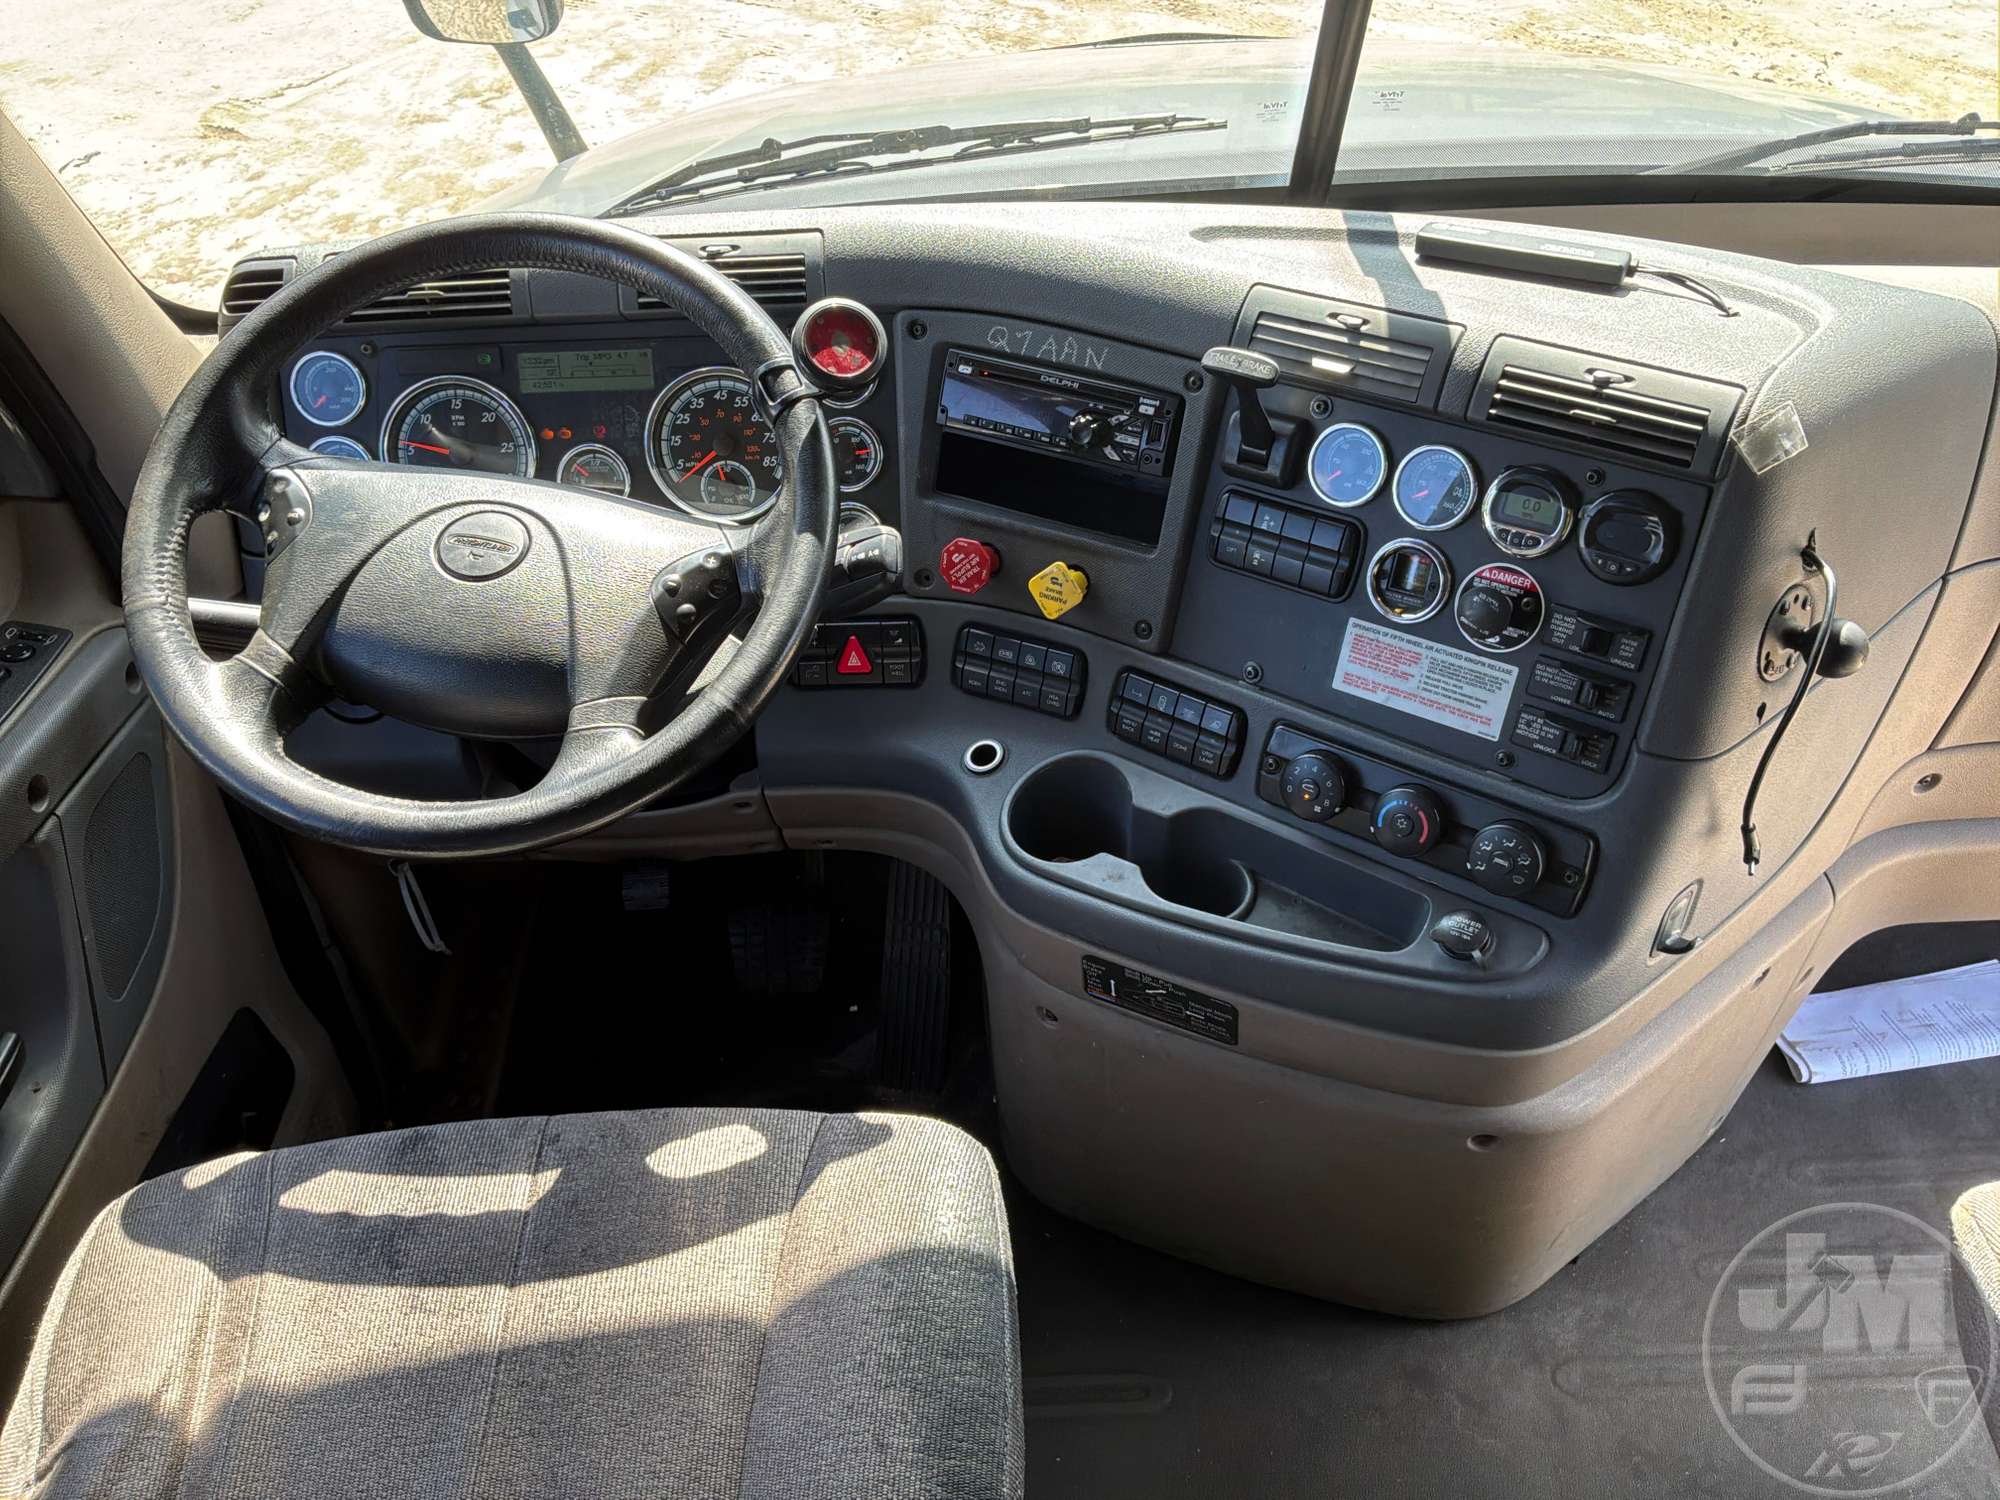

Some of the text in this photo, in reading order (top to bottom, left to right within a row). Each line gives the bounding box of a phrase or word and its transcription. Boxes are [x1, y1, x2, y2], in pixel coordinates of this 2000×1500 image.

[1040, 375, 1079, 389] DELPHI
[714, 390, 728, 400] 45
[451, 400, 462, 409] 15
[690, 398, 704, 408] 35
[734, 396, 749, 408] 55
[420, 414, 431, 424] 10
[481, 412, 496, 422] 20
[675, 413, 691, 424] 25
[670, 435, 682, 446] 15
[762, 433, 776, 443] 75
[408, 445, 415, 455] 5
[501, 442, 514, 453] 25
[676, 459, 684, 469] 5
[762, 456, 777, 467] 85
[1522, 499, 1541, 513] 0.0
[1490, 570, 1531, 587] DANGER
[1037, 592, 1067, 603] PARKING
[1549, 624, 1573, 634] DURING
[1550, 618, 1576, 629] ENGAGE
[1350, 622, 1382, 635] OPERATION
[1389, 634, 1405, 642] FIFTH
[1404, 638, 1424, 648] WHEEL
[1433, 647, 1463, 660] ACTUATED
[1462, 656, 1487, 667] KINGPIN
[1486, 663, 1513, 675] RELEASE
[1609, 657, 1635, 668] UNLOCK
[1548, 680, 1573, 690] MOTION
[1552, 675, 1577, 685] VEHICLE
[1596, 710, 1615, 718] AUTO
[1514, 729, 1540, 740] MOTION
[1532, 743, 1557, 753] UNLOCK
[1449, 920, 1479, 934] OUTLET
